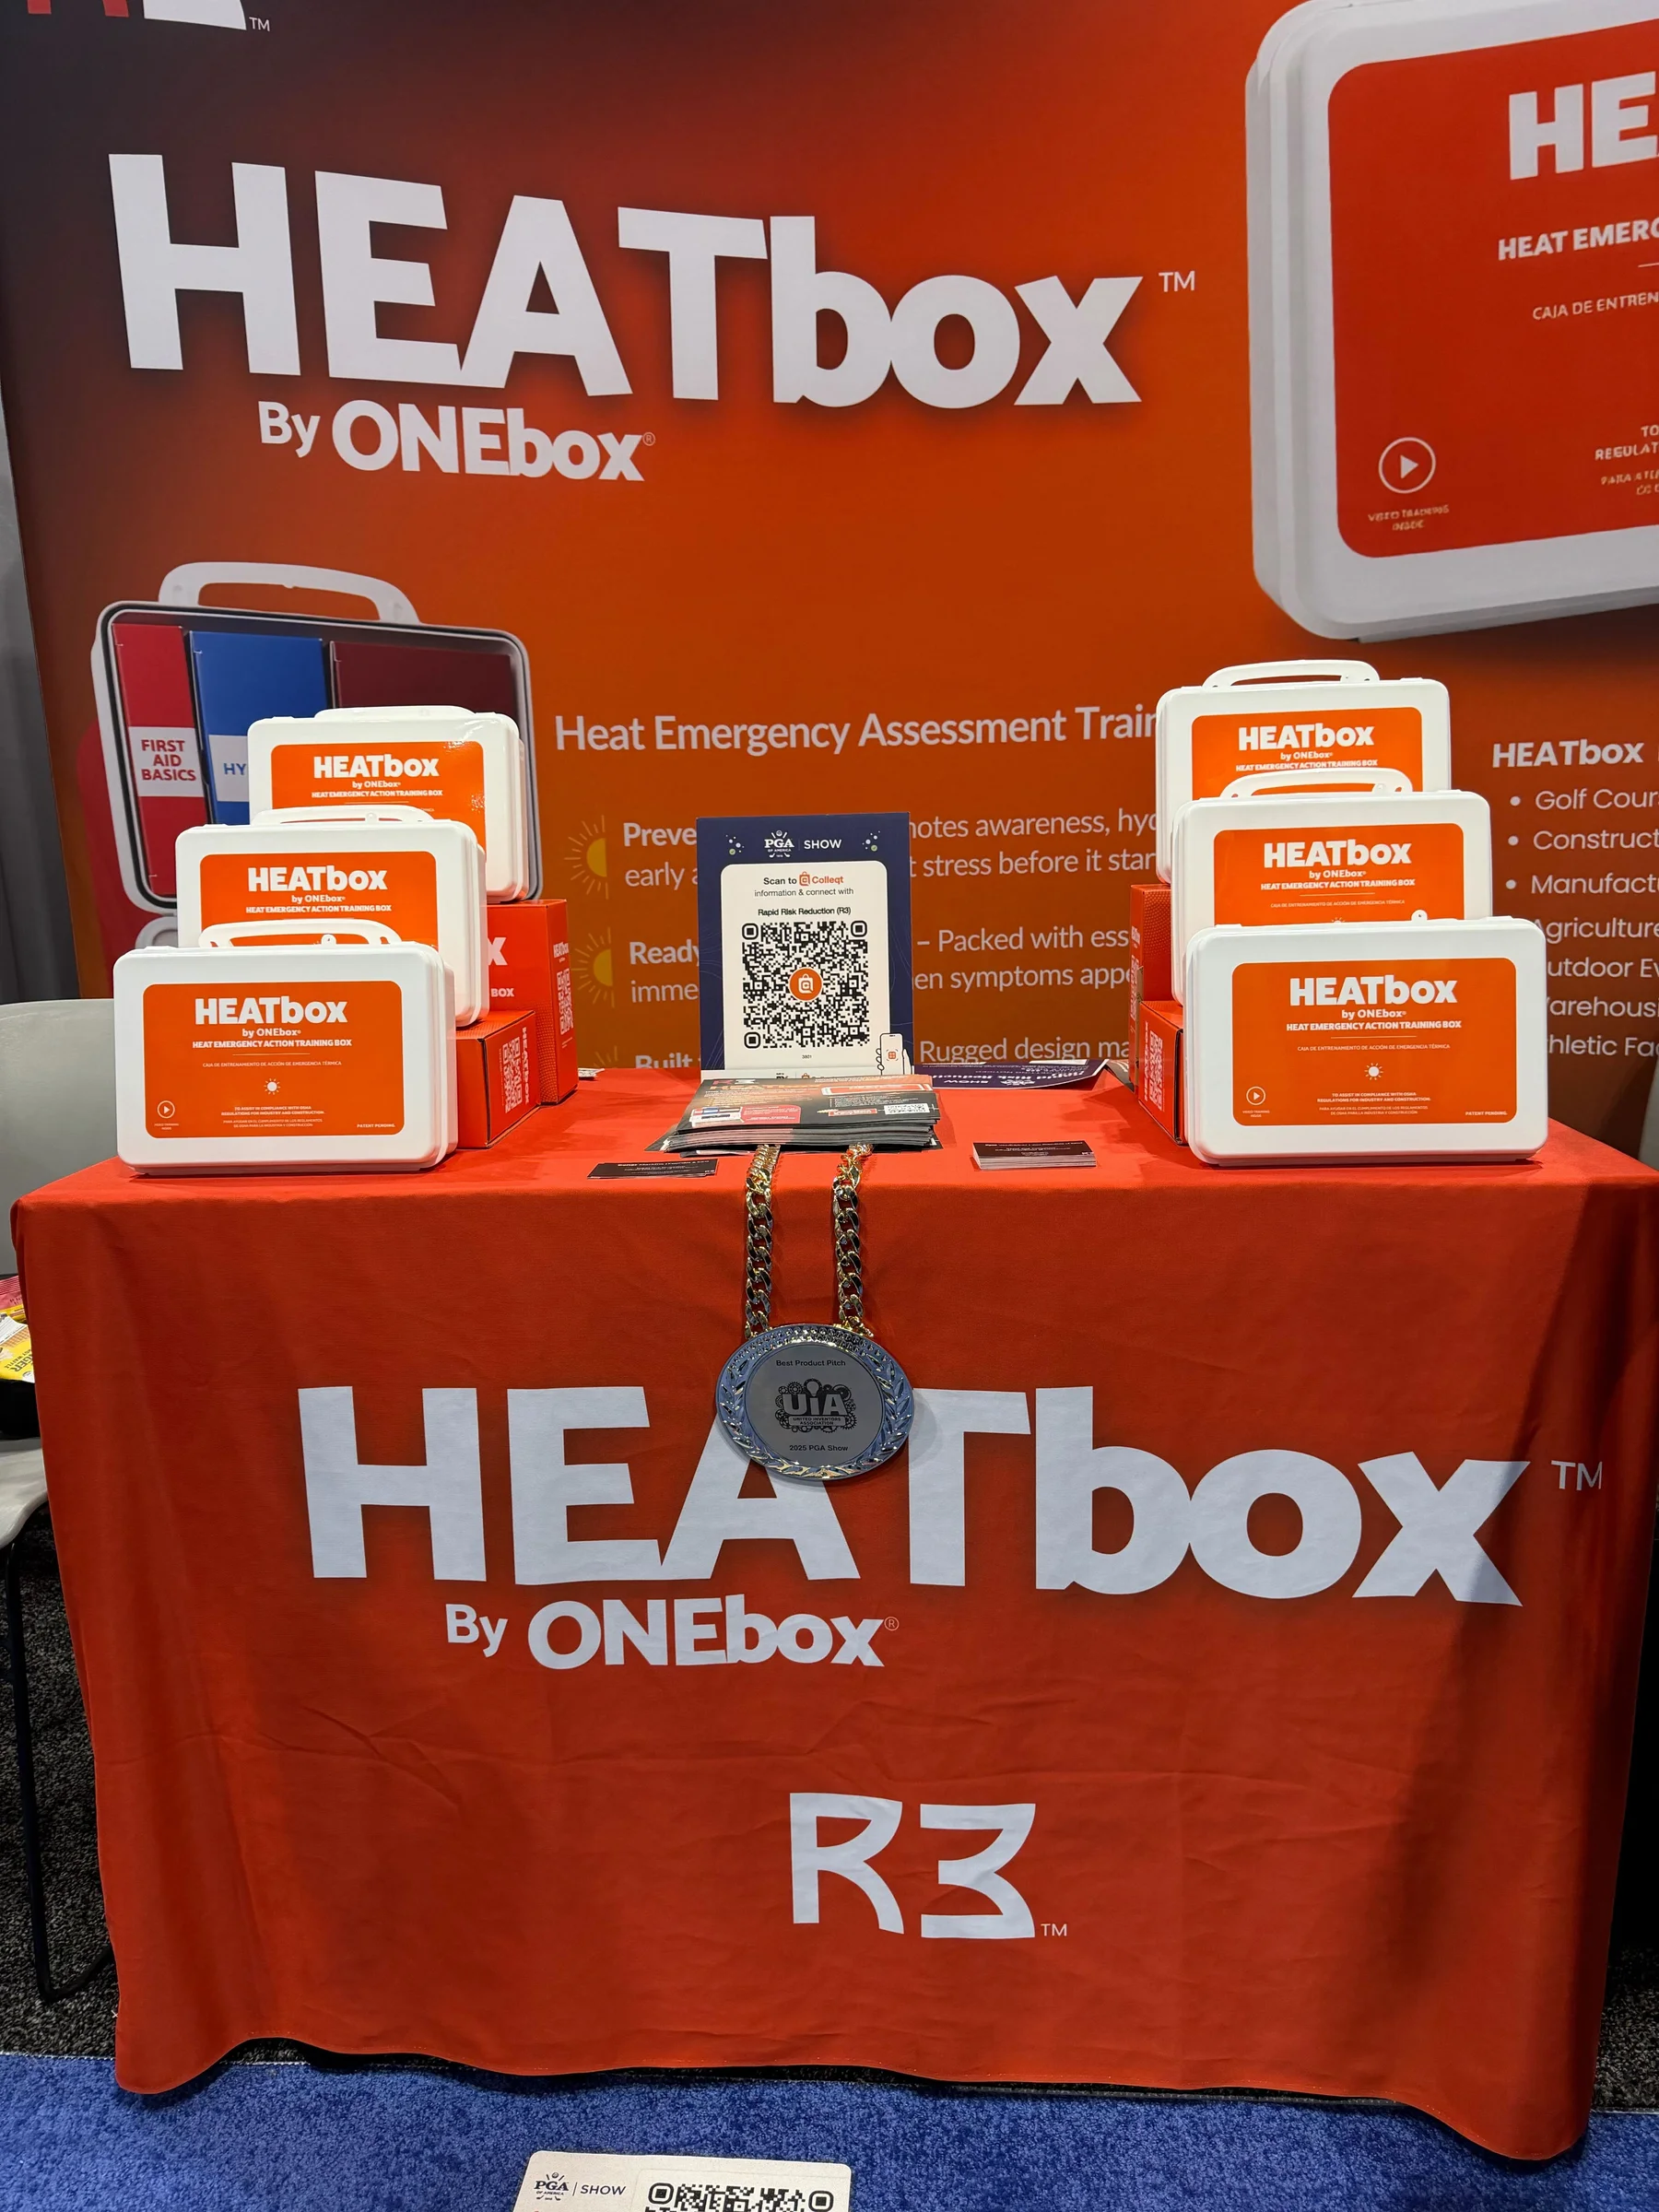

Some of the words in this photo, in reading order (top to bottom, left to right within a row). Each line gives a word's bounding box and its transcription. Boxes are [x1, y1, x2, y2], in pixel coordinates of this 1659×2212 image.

[1498, 230, 1568, 261] HEAT
[109, 153, 1143, 408] HEATbox
[1533, 304, 1569, 320] CAJA
[1572, 300, 1594, 314] DE
[1596, 291, 1659, 312] ENTREN
[258, 400, 321, 458] By
[555, 715, 645, 751] Heat
[654, 715, 851, 757] Emergency
[858, 710, 1066, 747] Assessment
[1238, 723, 1375, 751] HEATbox
[141, 739, 185, 752] FIRST
[1280, 752, 1292, 761] by
[1492, 738, 1644, 768] HEATbox
[153, 754, 182, 767] AID
[223, 762, 247, 776] HY
[313, 754, 440, 779] HEATbox
[1235, 764, 1254, 772] HEAT
[1255, 762, 1300, 771] EMERGENCY
[1300, 761, 1327, 770] ACTION
[141, 769, 196, 782] BASICS
[352, 781, 363, 789] by
[1535, 788, 1588, 811] Golf
[1593, 788, 1659, 809] Cour
[975, 811, 1111, 839] awareness,
[764, 838, 794, 849] PGA
[804, 839, 842, 850] SHOW
[1264, 839, 1412, 868] HEATbox
[923, 854, 992, 877] stress
[998, 850, 1079, 875] before
[1085, 850, 1102, 872] it
[1309, 870, 1321, 880] by
[248, 865, 388, 892] HEATbox
[625, 861, 686, 891] early
[763, 877, 786, 885] Scan
[788, 877, 797, 885] to
[812, 876, 844, 885] Colleqt
[1281, 882, 1329, 890] EMERGENCY
[1330, 880, 1359, 888] ACTION
[1359, 879, 1398, 888] TRAINING
[1398, 878, 1416, 887] BOX
[1531, 872, 1659, 895] Manufact
[291, 895, 303, 904] by
[758, 909, 780, 917] Rapid
[798, 907, 835, 915] Reduction
[837, 907, 852, 915] (R3)
[938, 926, 1023, 952] Packed
[1030, 925, 1084, 949] with
[1090, 929, 1130, 948] ess
[490, 988, 514, 997] BOX
[630, 980, 699, 1003] imme
[912, 971, 943, 991] en
[950, 967, 1074, 994] symptoms
[1289, 974, 1458, 1006] HEATbox
[194, 995, 348, 1025] HEATbox
[1342, 1009, 1355, 1020] by
[1547, 996, 1659, 1018] arehous
[241, 1029, 254, 1039] by
[1286, 1023, 1310, 1031] HEAT
[1310, 1022, 1364, 1030] EMERGENCY
[1365, 1021, 1398, 1030] ACTION
[1399, 1020, 1441, 1030] TRAINING
[1442, 1020, 1462, 1029] BOX
[334, 1039, 352, 1047] BOX
[920, 1038, 1007, 1064] Rugged
[1019, 1036, 1090, 1061] design
[1547, 1034, 1618, 1055] hletic
[1625, 1037, 1659, 1057] Fa
[298, 1385, 1530, 1607] HEATbox
[445, 1604, 508, 1657] By
[790, 1793, 1036, 1939] R3
[534, 2181, 569, 2191] PGA
[581, 2185, 626, 2195] SHOW
